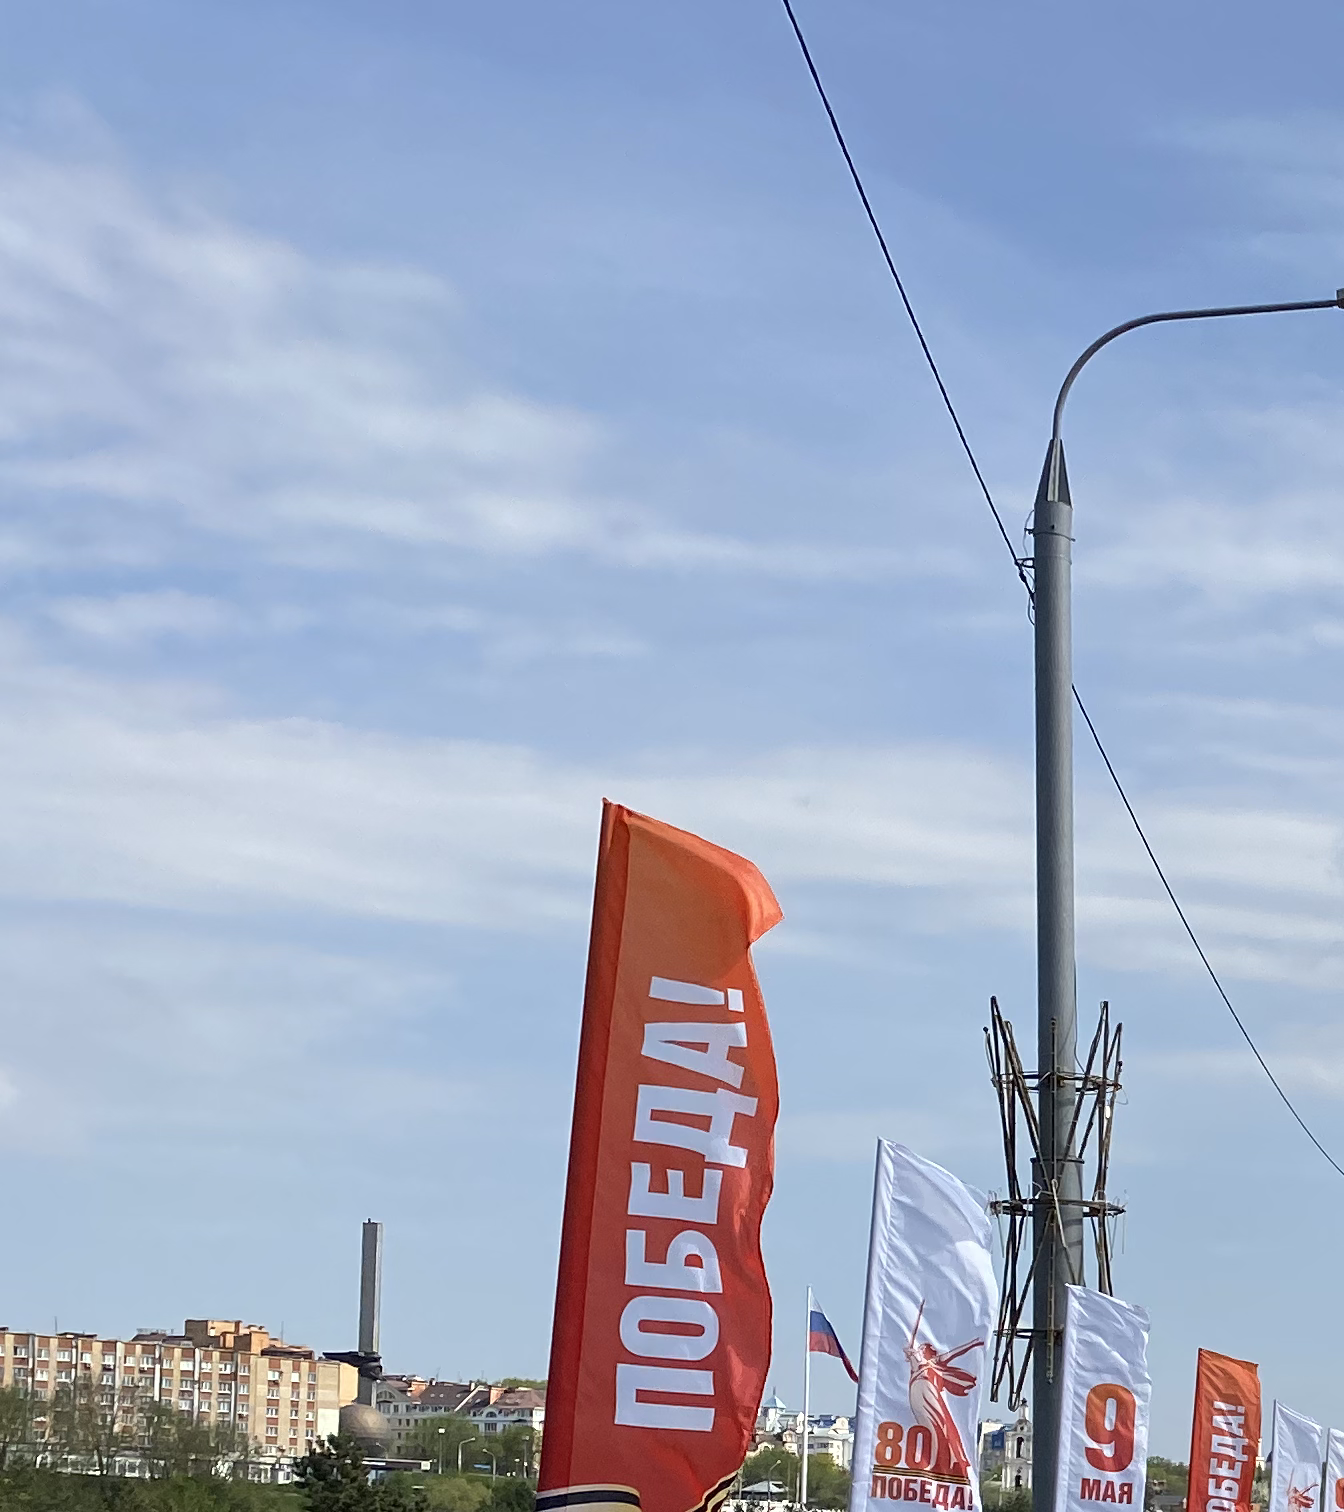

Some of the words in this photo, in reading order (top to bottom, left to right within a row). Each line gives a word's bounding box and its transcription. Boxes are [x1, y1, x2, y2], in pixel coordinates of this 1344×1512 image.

[614, 976, 759, 1433] ПОБЕДА!
[874, 1421, 933, 1471] 80
[1084, 1383, 1137, 1472] 9
[870, 1474, 974, 1511] ПОБЕДА!
[1080, 1477, 1134, 1505] МАЯ
